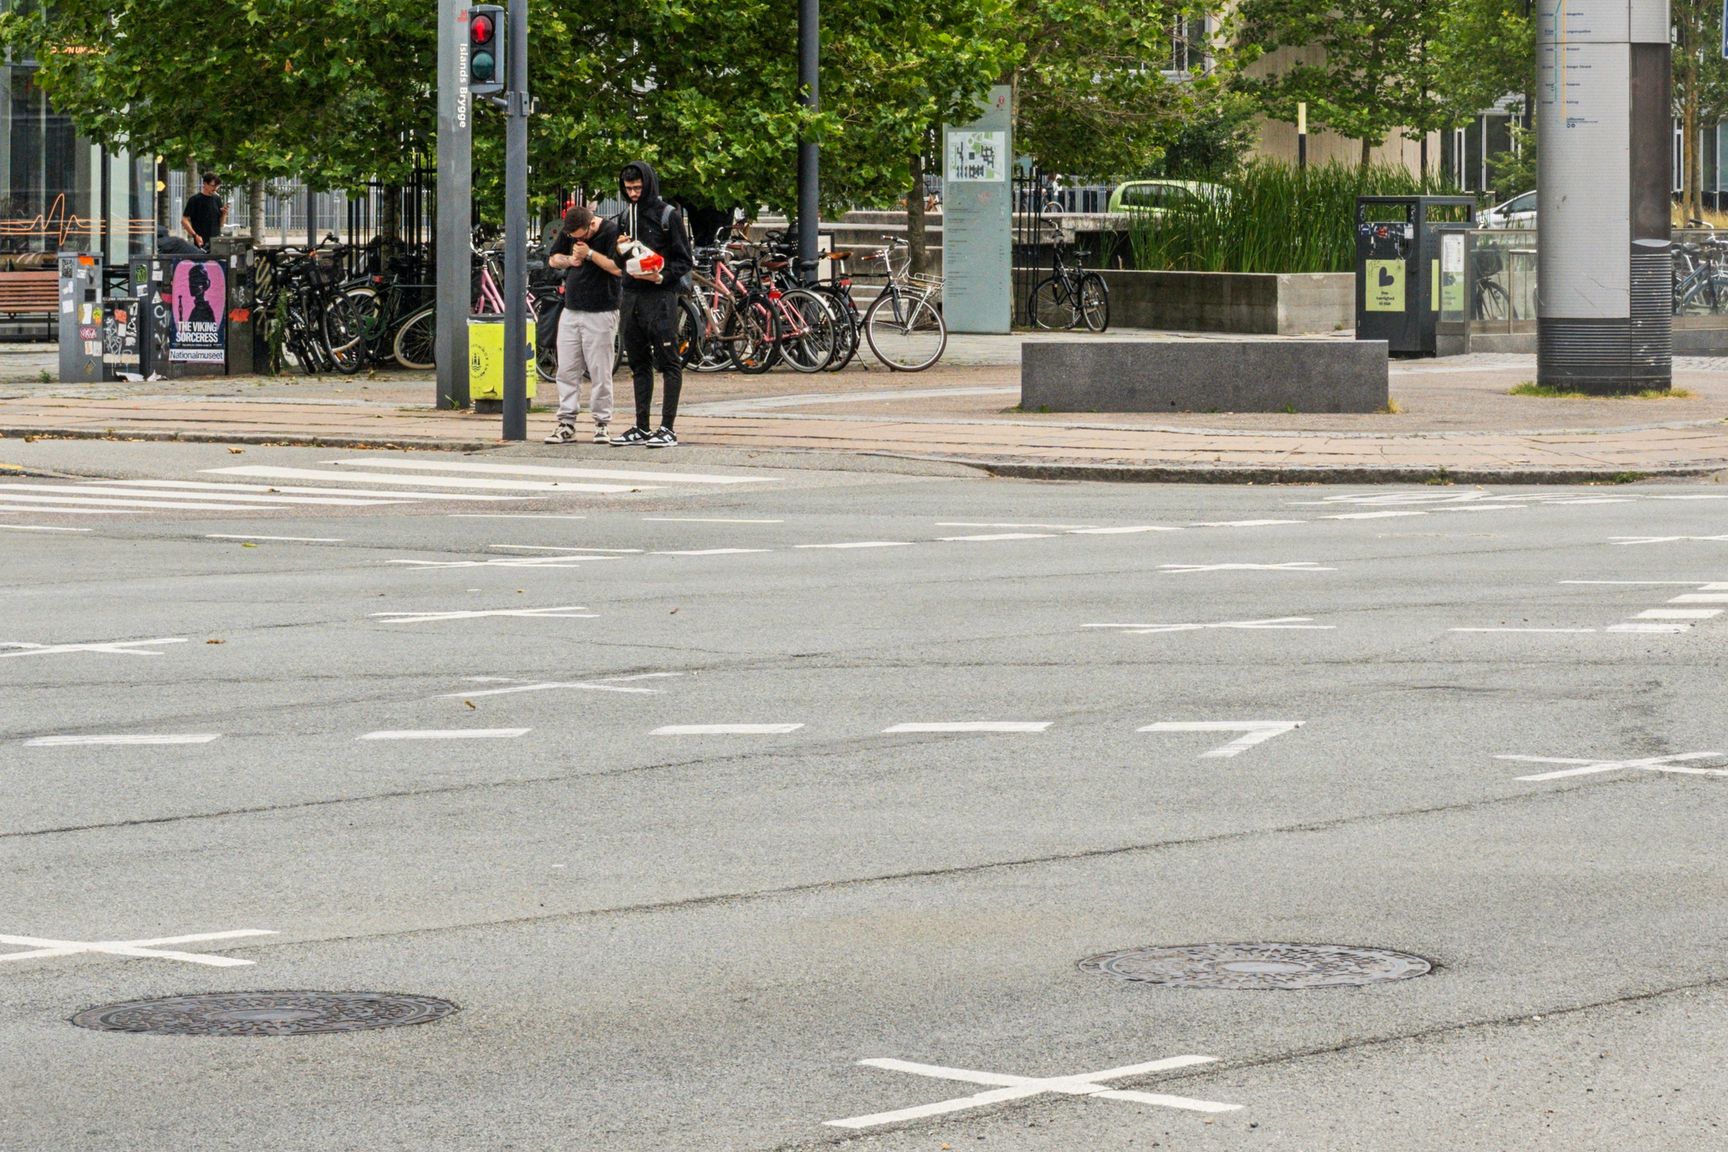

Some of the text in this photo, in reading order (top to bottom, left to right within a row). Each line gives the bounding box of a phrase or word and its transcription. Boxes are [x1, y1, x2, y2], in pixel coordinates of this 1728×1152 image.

[457, 43, 468, 128] Islands Brygge
[178, 321, 218, 332] THE VIKING
[175, 332, 219, 343] SORCERESS
[170, 350, 223, 359] Nationalmuseet
